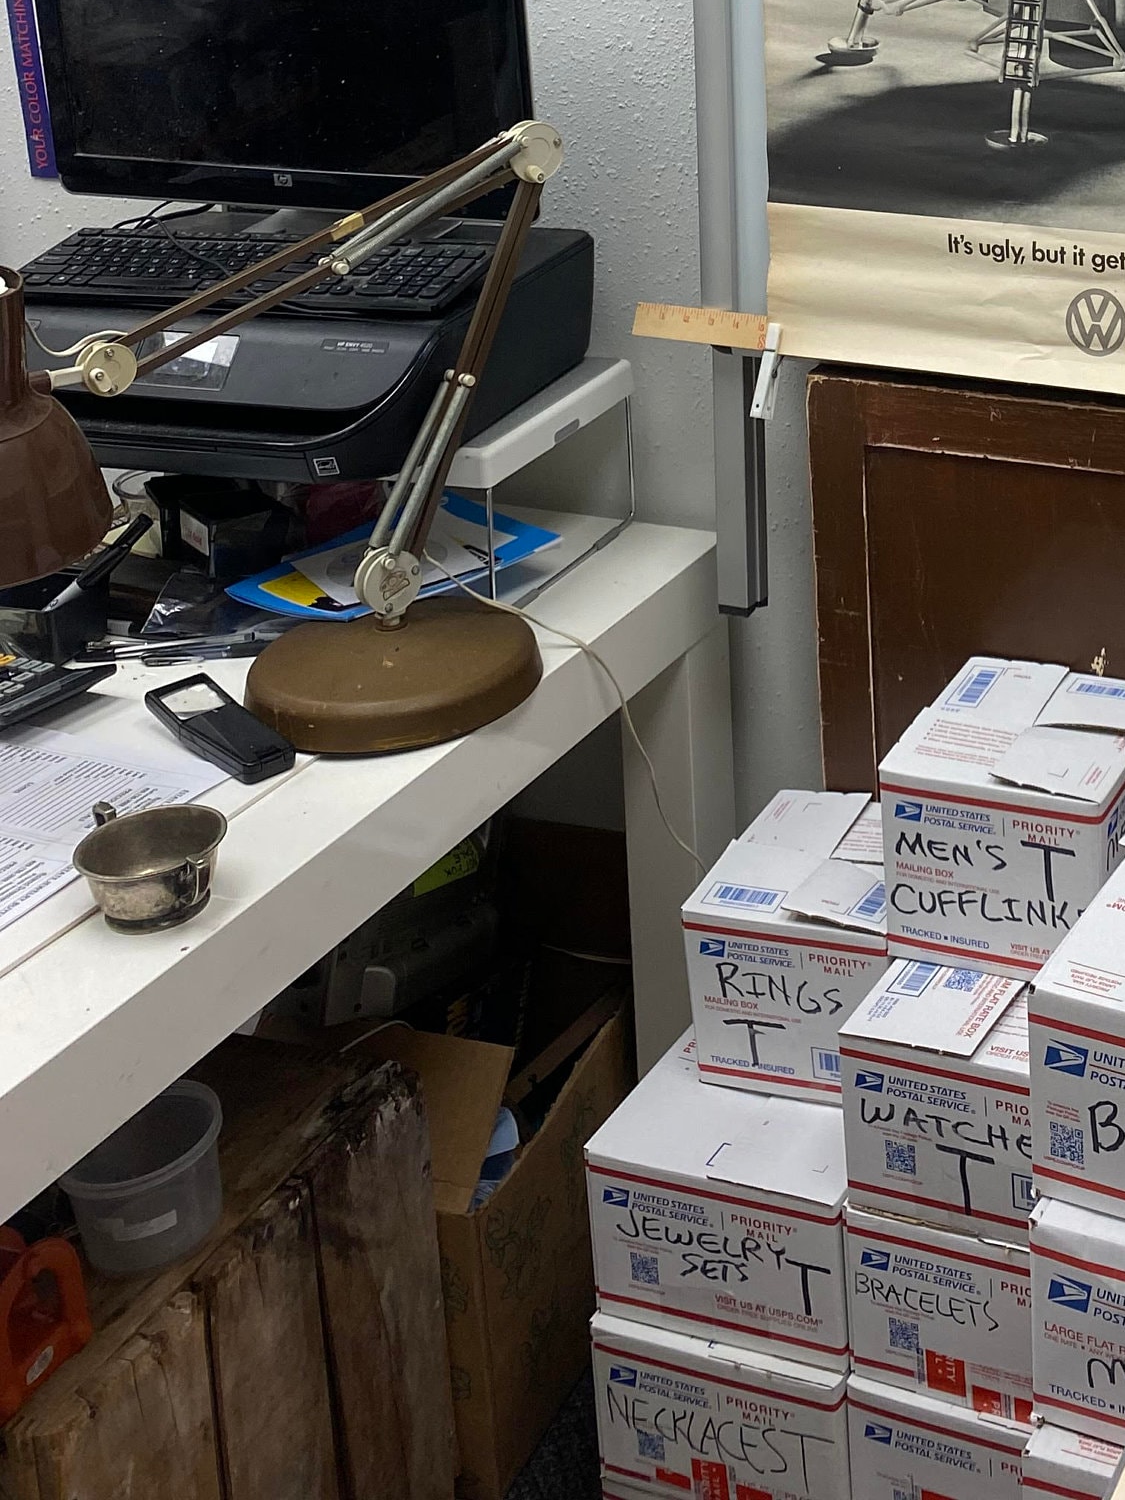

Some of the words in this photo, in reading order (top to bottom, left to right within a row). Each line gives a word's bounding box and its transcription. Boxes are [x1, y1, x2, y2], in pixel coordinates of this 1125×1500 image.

[23, 70, 42, 124] COLOR
[31, 128, 49, 169] YOUR
[948, 233, 973, 255] It's
[979, 239, 1025, 265] ugly,
[1031, 241, 1066, 264] but
[1073, 245, 1086, 266] it
[924, 816, 957, 828] POSTAL
[925, 805, 959, 817] UNITED
[960, 809, 991, 822] STATES
[895, 831, 1007, 871] MEN'S
[1028, 833, 1060, 846] MAIL
[896, 861, 933, 875] MAILING
[934, 866, 954, 879] BOX
[1020, 840, 1076, 902] T
[728, 941, 759, 952] UNITED
[760, 946, 789, 957] STATES
[901, 925, 942, 941] TRACKED
[950, 935, 990, 949] INSURED
[727, 952, 758, 963] POSTAL
[823, 966, 854, 977] MAIL
[715, 962, 843, 1015] RINGS
[704, 995, 739, 1007] MAILING
[741, 1000, 759, 1010] BOX
[723, 1019, 786, 1067] T
[990, 1045, 1014, 1055] VISIT
[710, 1055, 750, 1067] TRACKED
[886, 1087, 925, 1103] POSTAL
[888, 1075, 929, 1092] UNITED
[930, 1085, 967, 1100] STATES
[935, 1143, 995, 1216] T
[631, 1202, 668, 1217] POSTAL
[633, 1191, 670, 1206] UNITED
[670, 1200, 705, 1215] STATES
[616, 1209, 786, 1271] JEWELRY
[746, 1228, 778, 1243] MAIL
[680, 1253, 749, 1283] SETS
[892, 1266, 931, 1282] POSTAL
[894, 1255, 934, 1271] UNITED
[935, 1265, 972, 1281] STATES
[785, 1258, 832, 1316] T
[855, 1271, 1000, 1332] BRACELETS
[1045, 1321, 1084, 1342] LARGE
[1087, 1336, 1115, 1351] FLAT
[639, 1383, 672, 1399] POSTAL
[640, 1371, 674, 1387] UNITED
[674, 1381, 705, 1396] STATES
[1049, 1384, 1106, 1409] TRACKED
[743, 1412, 775, 1427] MAIL
[894, 1442, 931, 1461] POSTAL
[896, 1430, 935, 1450] UNITED
[937, 1442, 972, 1459] STATES
[780, 1430, 835, 1494] T
